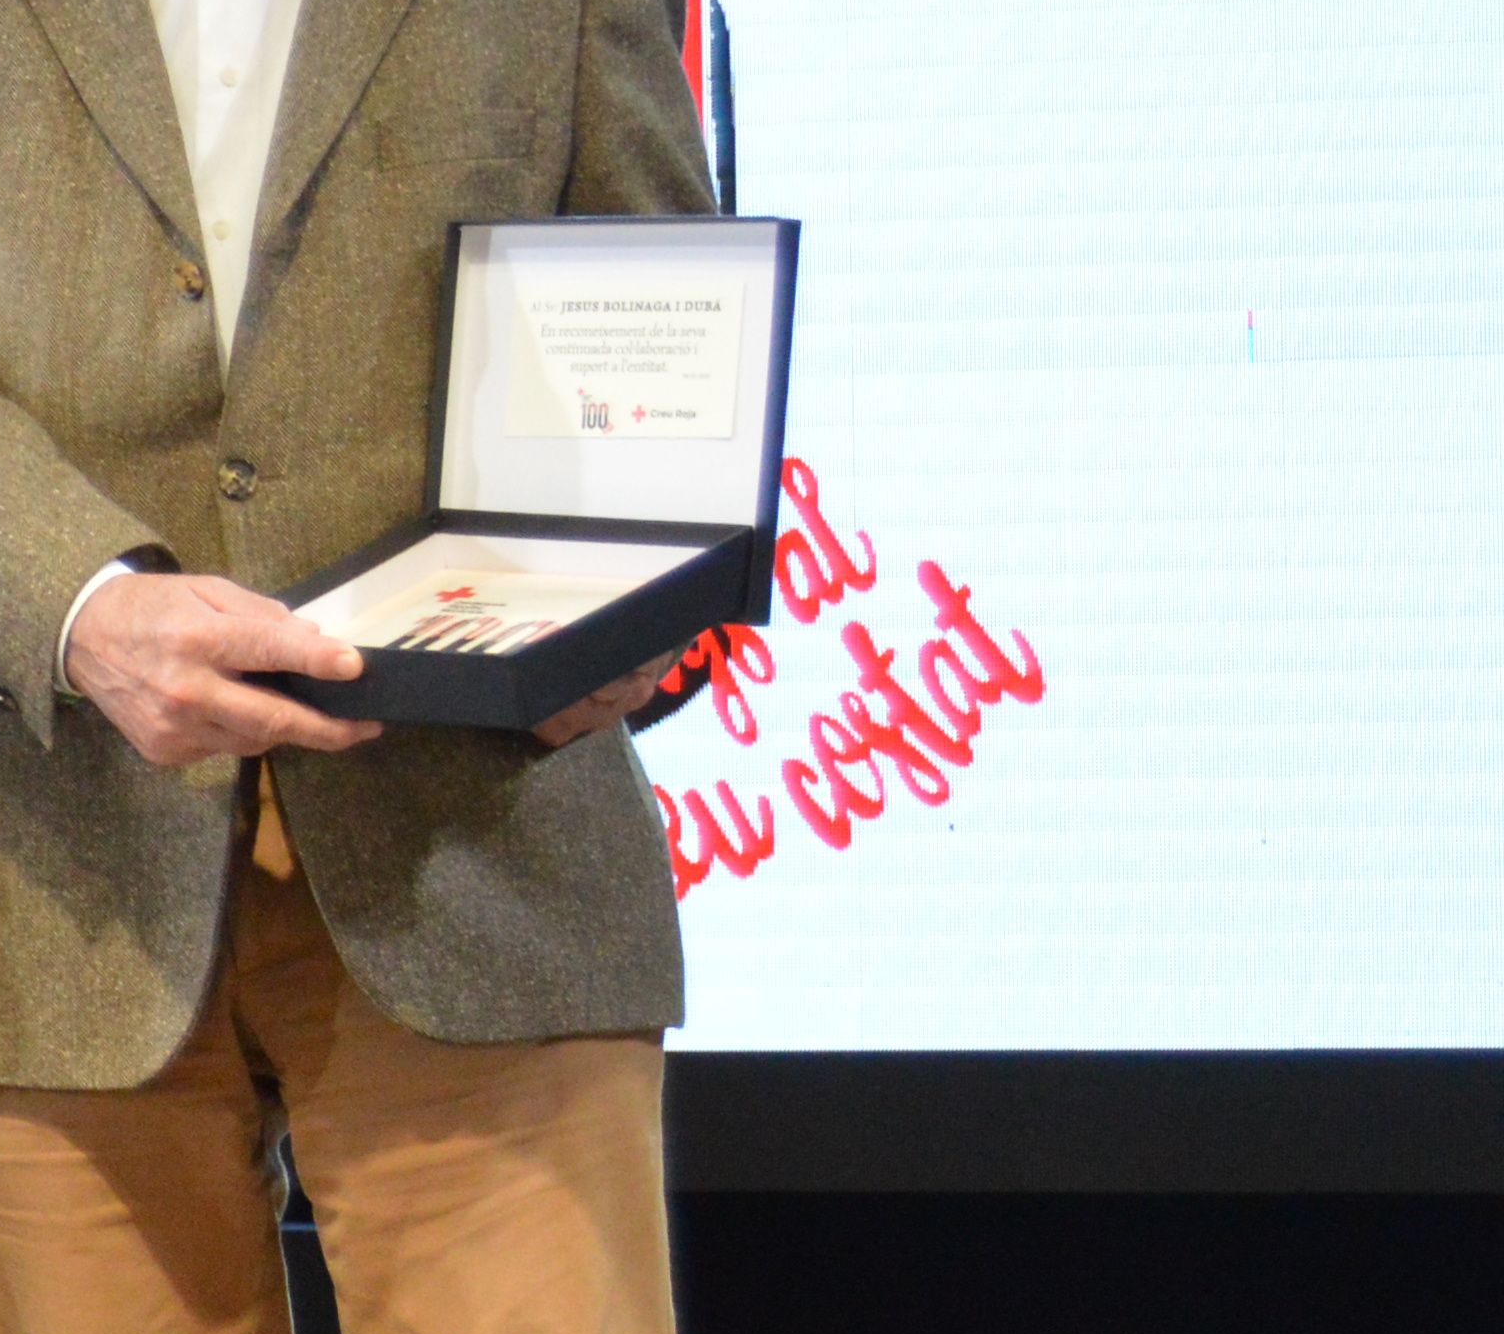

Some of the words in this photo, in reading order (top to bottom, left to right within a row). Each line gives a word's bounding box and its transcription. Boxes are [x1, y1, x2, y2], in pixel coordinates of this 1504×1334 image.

[559, 301, 600, 315] JESUS
[604, 301, 672, 313] BOLINAGA
[674, 301, 680, 313] I
[541, 323, 557, 338] En
[558, 324, 647, 338] reconeixement
[649, 322, 663, 338] de
[666, 323, 677, 338] la
[679, 327, 706, 338] seva
[545, 340, 612, 355] continuada
[570, 360, 608, 376] suport
[611, 362, 618, 373] a
[580, 401, 609, 430] 100
[651, 408, 673, 419] Creu
[675, 408, 697, 420] Roja
[774, 455, 877, 625] al
[780, 560, 1048, 851] costat
